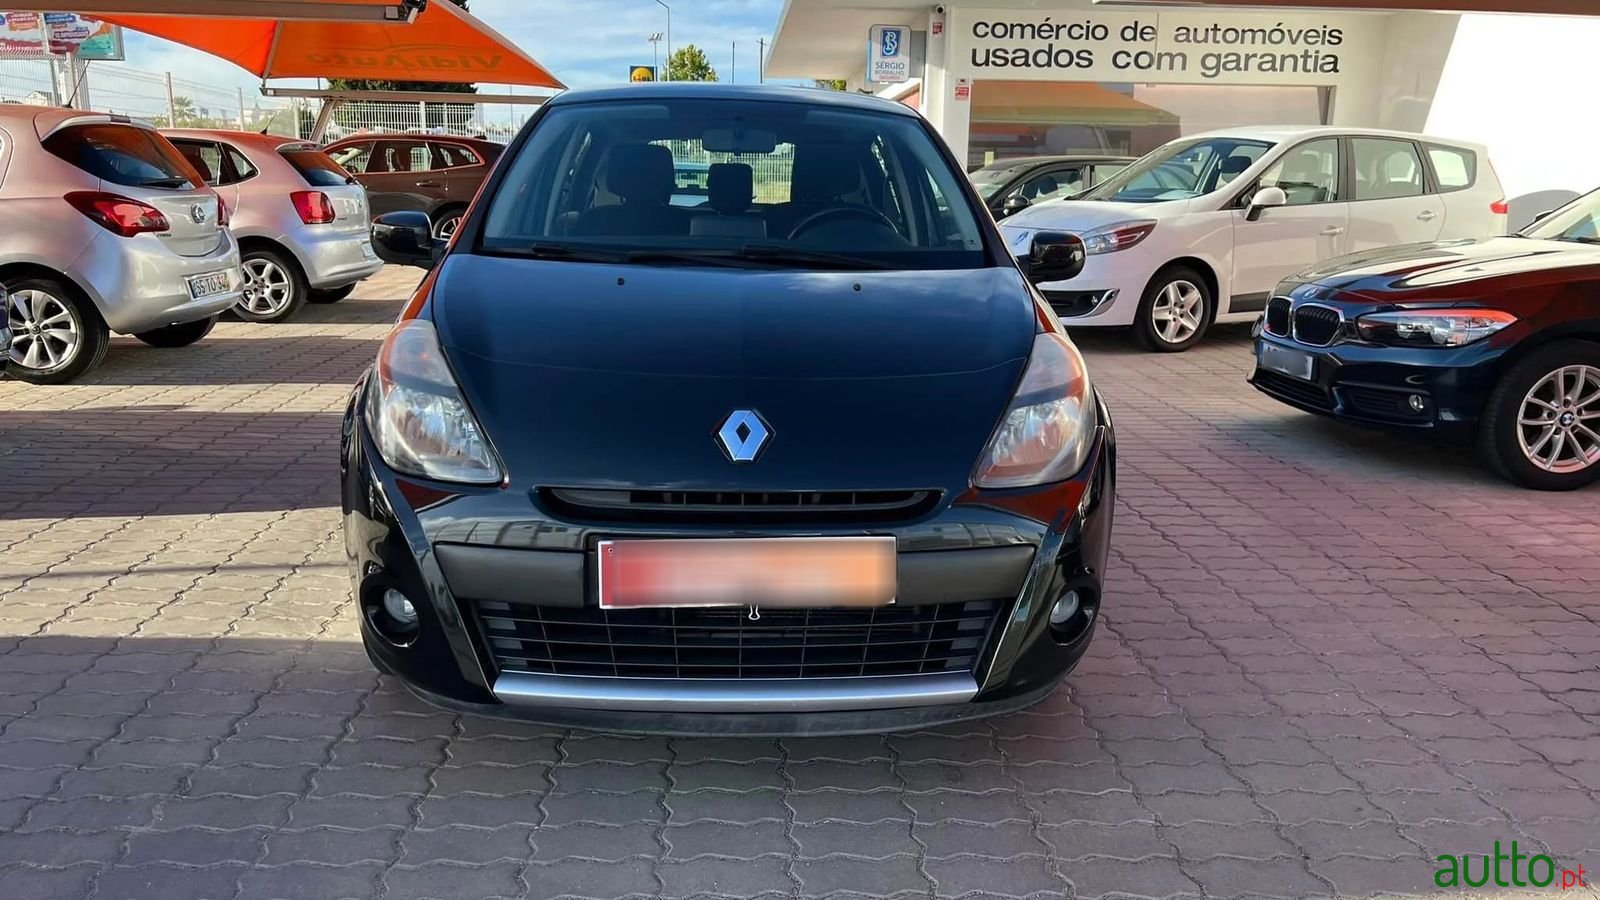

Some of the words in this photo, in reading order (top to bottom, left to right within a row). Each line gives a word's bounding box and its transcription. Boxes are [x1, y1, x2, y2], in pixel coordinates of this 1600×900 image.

[972, 17, 1108, 41] comércio
[1120, 20, 1157, 42] de
[1173, 22, 1344, 46] automóveis
[875, 61, 905, 70] SÉRGIO
[971, 43, 1094, 68] usados
[1111, 50, 1188, 71] com
[1200, 49, 1340, 78] garantia
